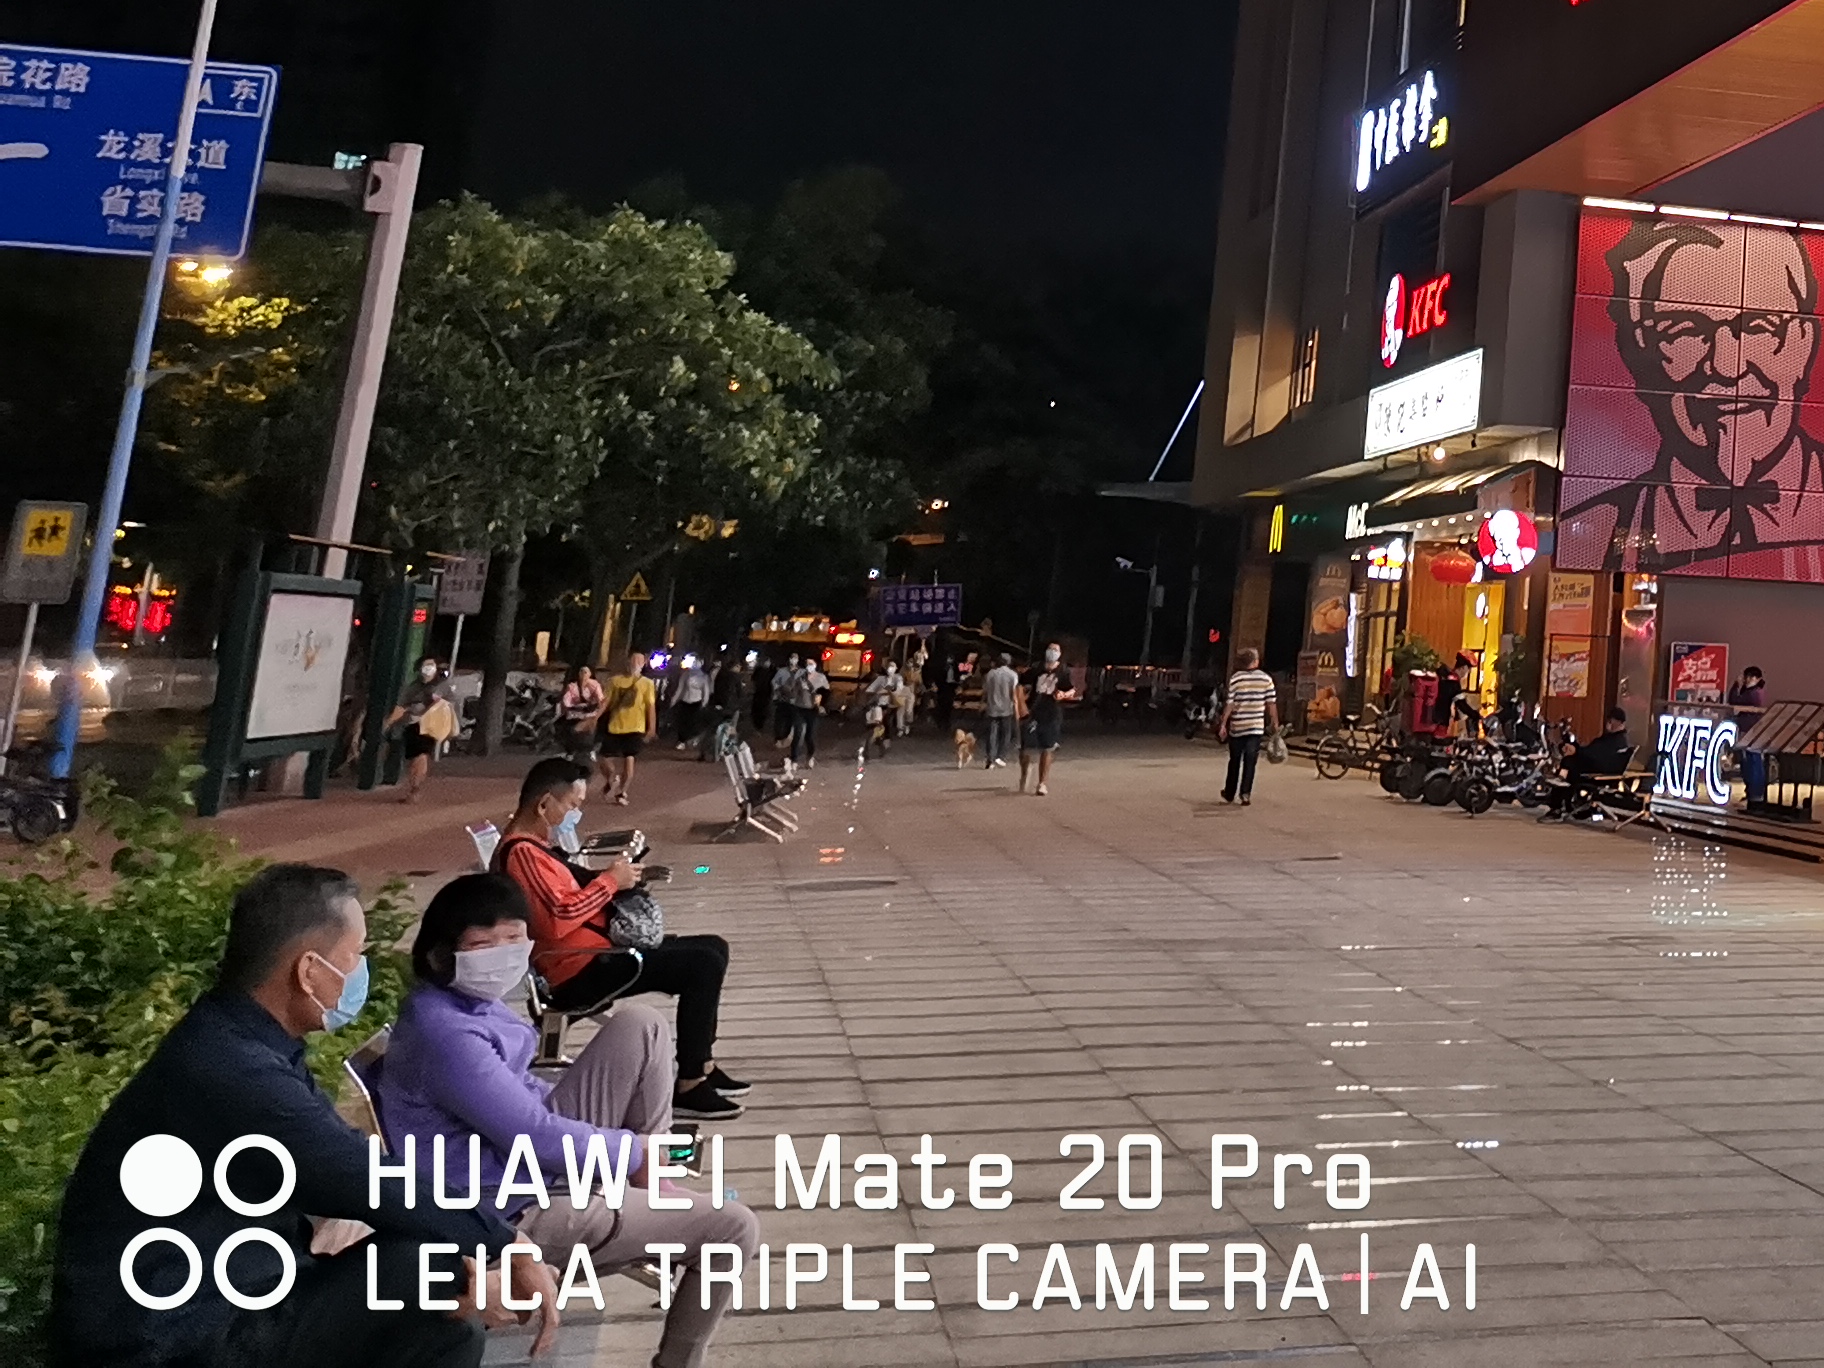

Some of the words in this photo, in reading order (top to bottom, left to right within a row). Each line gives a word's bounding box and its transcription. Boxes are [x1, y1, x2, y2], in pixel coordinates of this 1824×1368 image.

[97, 129, 229, 169] 龙溪道
[1407, 273, 1451, 338] KFC
[1653, 715, 1738, 806] KFC
